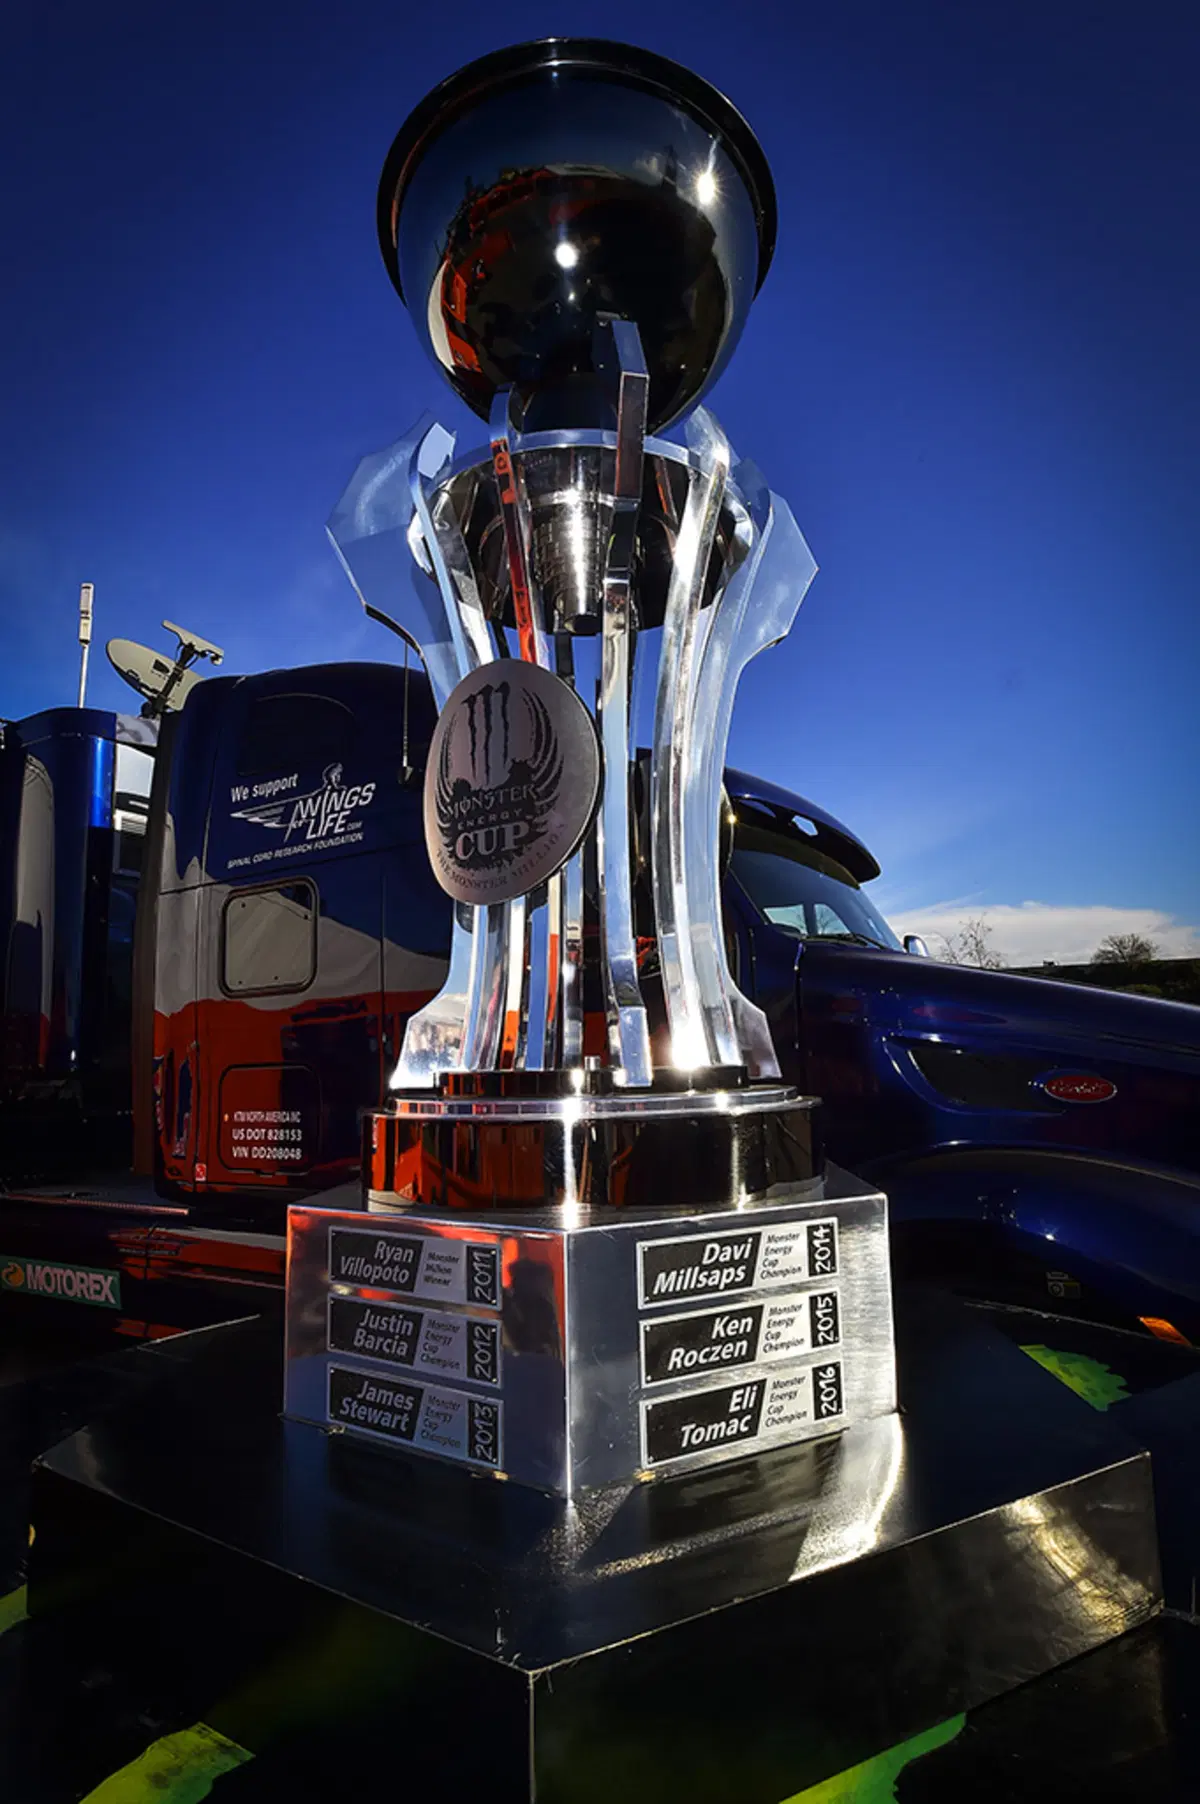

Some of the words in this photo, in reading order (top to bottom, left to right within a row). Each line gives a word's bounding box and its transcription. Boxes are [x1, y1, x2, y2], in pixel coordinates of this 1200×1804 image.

[231, 785, 249, 803] We
[252, 773, 298, 798] support
[297, 782, 376, 819] WINGS
[447, 783, 538, 819] MONSTER
[306, 810, 350, 840] LIFE
[458, 808, 523, 830] ENERGY
[274, 843, 312, 859] RESEARCH
[313, 832, 364, 851] FOUNDATION
[455, 821, 530, 861] CUP
[231, 1128, 245, 1141] US
[246, 1128, 267, 1141] DOT
[231, 1145, 249, 1159] VIN
[764, 1243, 792, 1257] Energy
[767, 1231, 800, 1244] Monster
[812, 1225, 831, 1273] 2014
[374, 1240, 415, 1264] Ryan
[701, 1238, 753, 1266] Davi
[762, 1257, 779, 1269] Cup
[340, 1256, 410, 1284] Villopoto
[473, 1250, 492, 1300] 2011
[653, 1264, 746, 1295] Millsaps
[760, 1264, 802, 1280] Champion
[26, 1263, 116, 1305] MOTOREX
[359, 1308, 414, 1334] Justin
[769, 1303, 803, 1316] Monster
[816, 1295, 833, 1345] 2015
[711, 1316, 753, 1340] Ken
[765, 1330, 782, 1342] Cup
[767, 1316, 796, 1330] Energy
[353, 1328, 409, 1357] Barcia
[425, 1331, 453, 1346] Energy
[762, 1336, 805, 1354] Champion
[420, 1353, 460, 1371] Champion
[474, 1325, 492, 1380] 2012
[667, 1339, 748, 1371] Roczen
[772, 1375, 806, 1389] Monster
[820, 1366, 837, 1417] 2016
[357, 1380, 414, 1411] James
[728, 1386, 758, 1413] Eli
[769, 1389, 798, 1403] Energy
[340, 1396, 410, 1432] Stewart
[425, 1405, 453, 1423] Energy
[765, 1409, 808, 1428] Champion
[767, 1404, 784, 1416] Cup
[421, 1429, 461, 1449] Champion
[475, 1404, 493, 1460] 2013
[681, 1414, 752, 1448] Tomac
